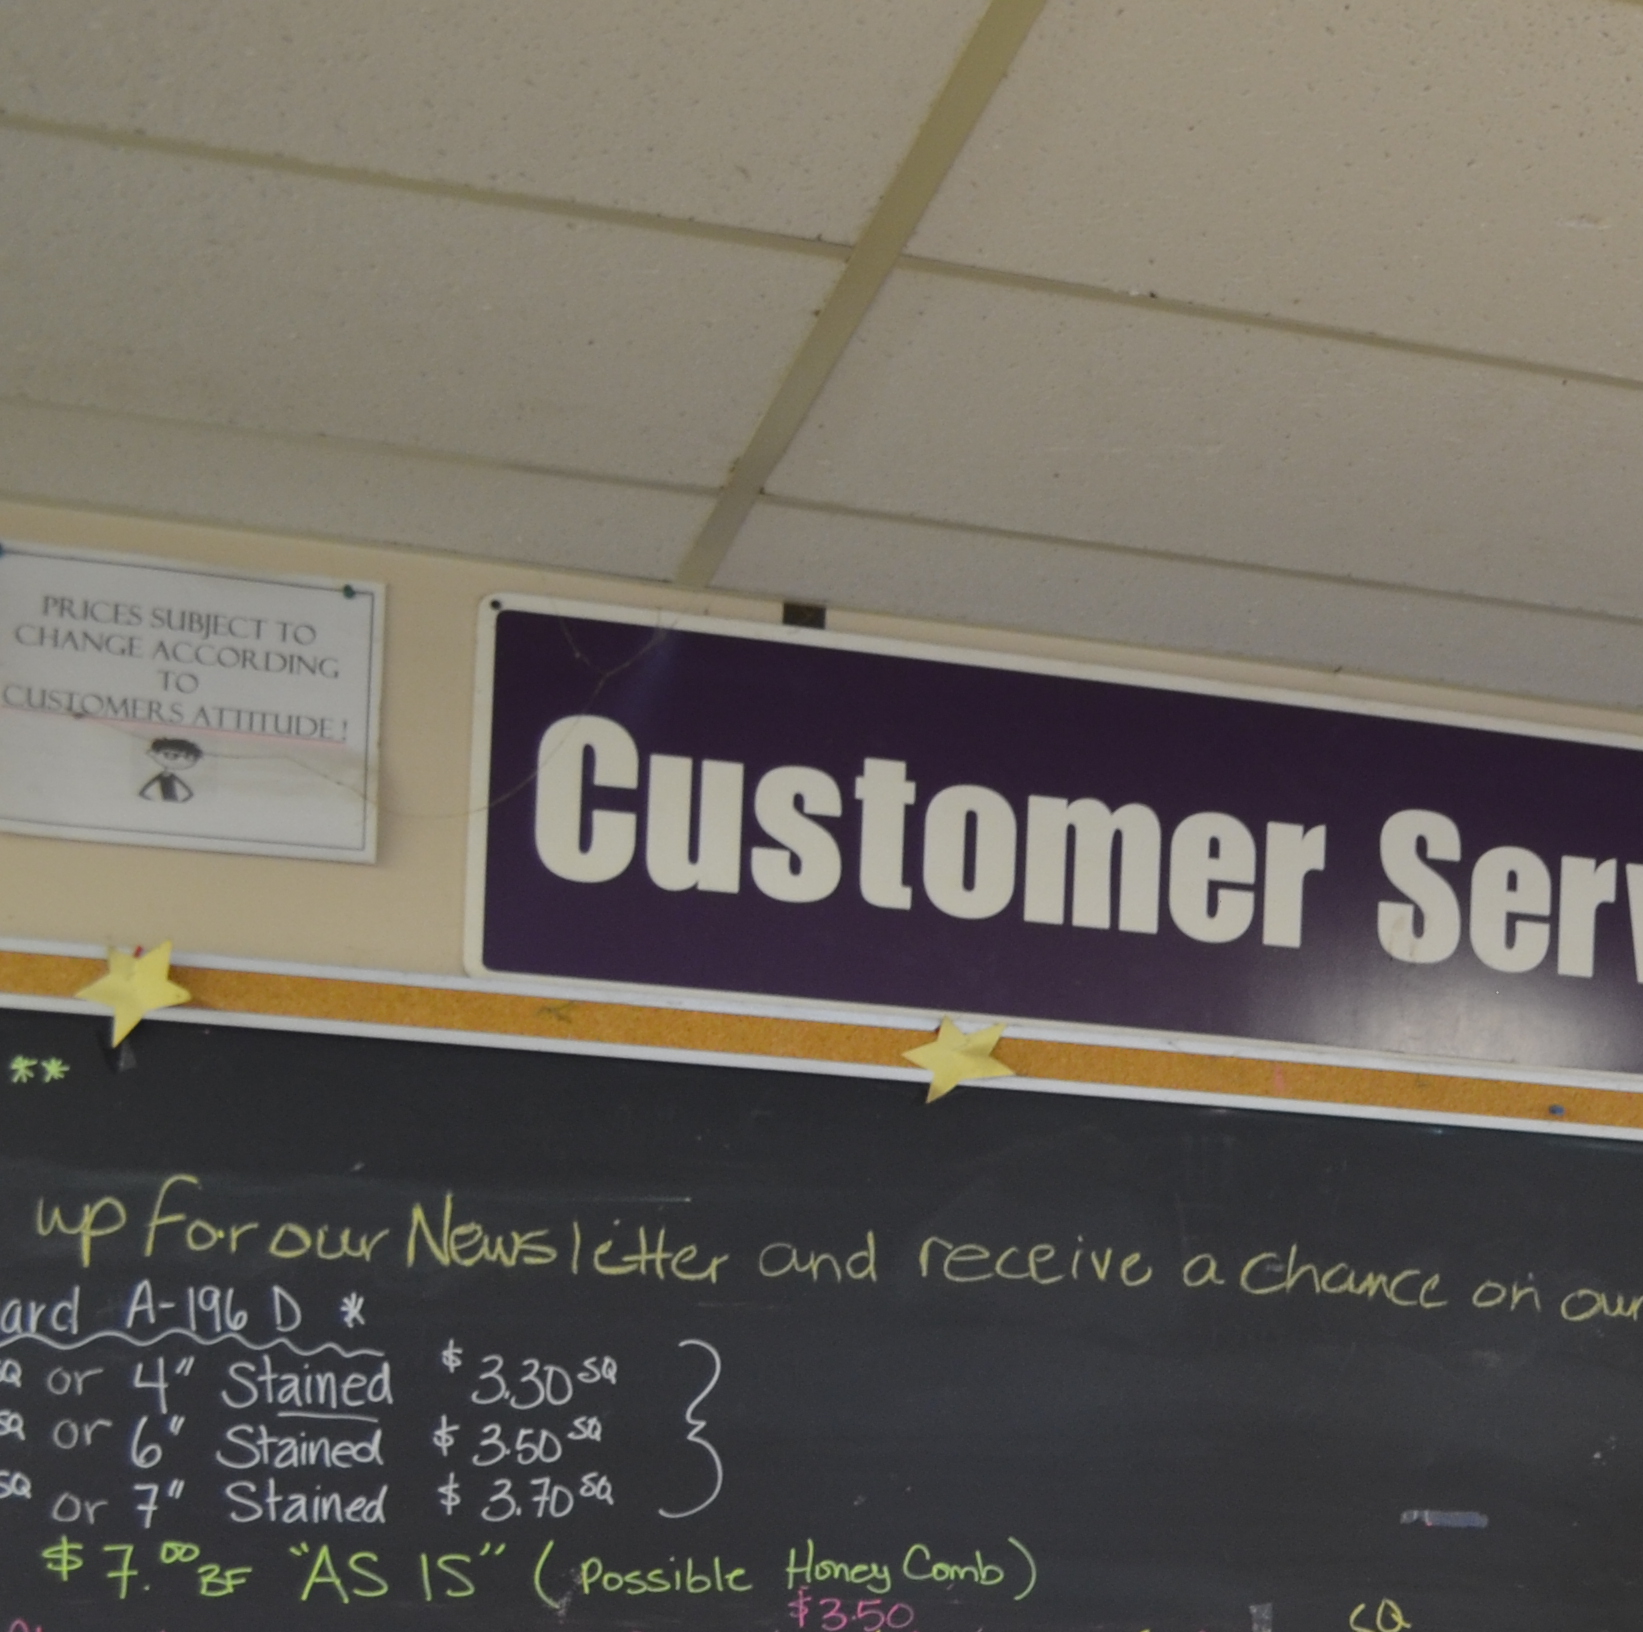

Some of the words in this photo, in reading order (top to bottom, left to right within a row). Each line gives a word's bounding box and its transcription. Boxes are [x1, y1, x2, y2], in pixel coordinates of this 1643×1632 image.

[40, 595, 142, 626] PRICES
[150, 608, 267, 642] SUBJECT
[275, 620, 316, 645] TO
[14, 624, 143, 659] CHANGE
[152, 640, 340, 679] ACCORDING
[2, 683, 184, 726] CUSTOMERS
[158, 669, 199, 694] TO
[532, 714, 1325, 950] Customer
[36, 1196, 127, 1266] up
[269, 1222, 389, 1263] our
[406, 1190, 729, 1282] Newsletter
[759, 1231, 877, 1284] and
[920, 1235, 1152, 1287] receive
[1184, 1251, 1225, 1288] a
[1472, 1272, 1541, 1311] on
[47, 1365, 103, 1395] or
[222, 1354, 393, 1406] Stained
[53, 1418, 112, 1449] or
[216, 1425, 383, 1471] Stained
[52, 1492, 108, 1526] or
[230, 1482, 386, 1525] Stained
[785, 1539, 892, 1594] Honey
